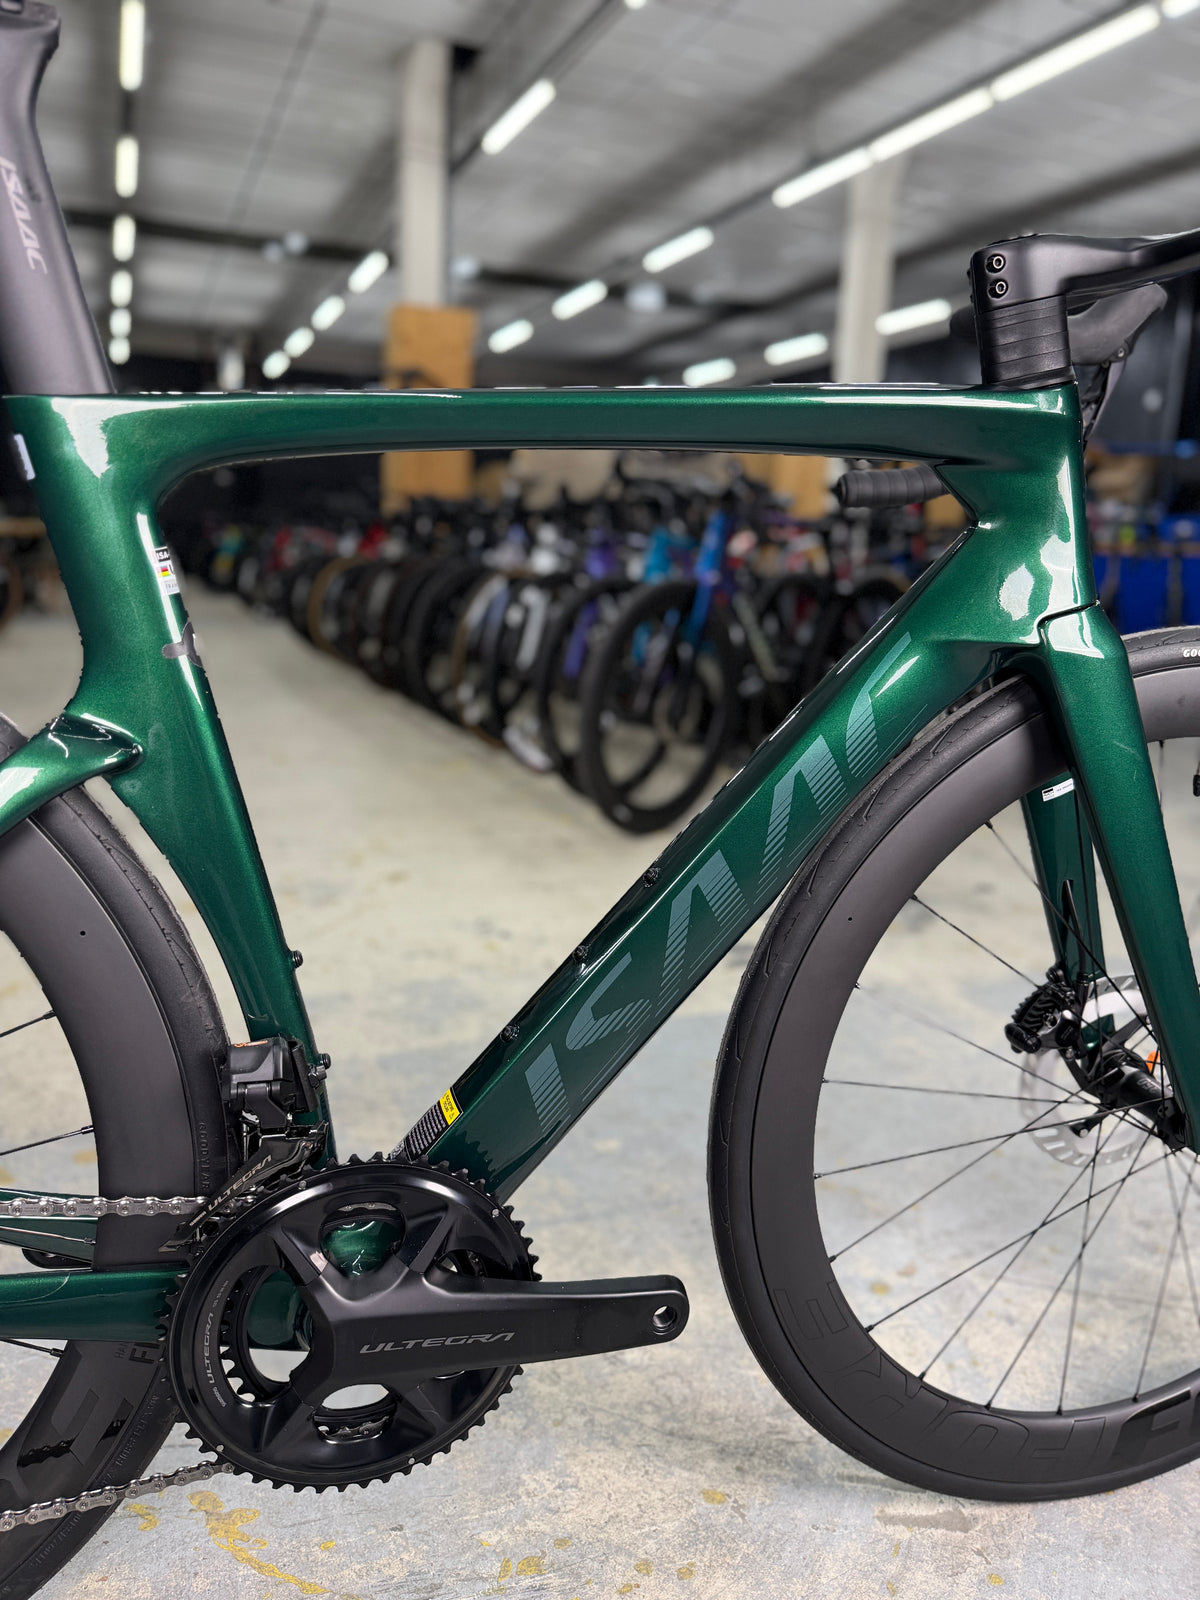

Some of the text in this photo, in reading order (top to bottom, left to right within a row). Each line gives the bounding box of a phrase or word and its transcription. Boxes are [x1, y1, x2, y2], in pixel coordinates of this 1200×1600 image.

[524, 632, 914, 1132] ISAAC
[208, 1154, 272, 1211] ULTEGRA
[204, 1312, 215, 1384] ULTEGRA
[360, 1332, 515, 1354] ULTEGRA
